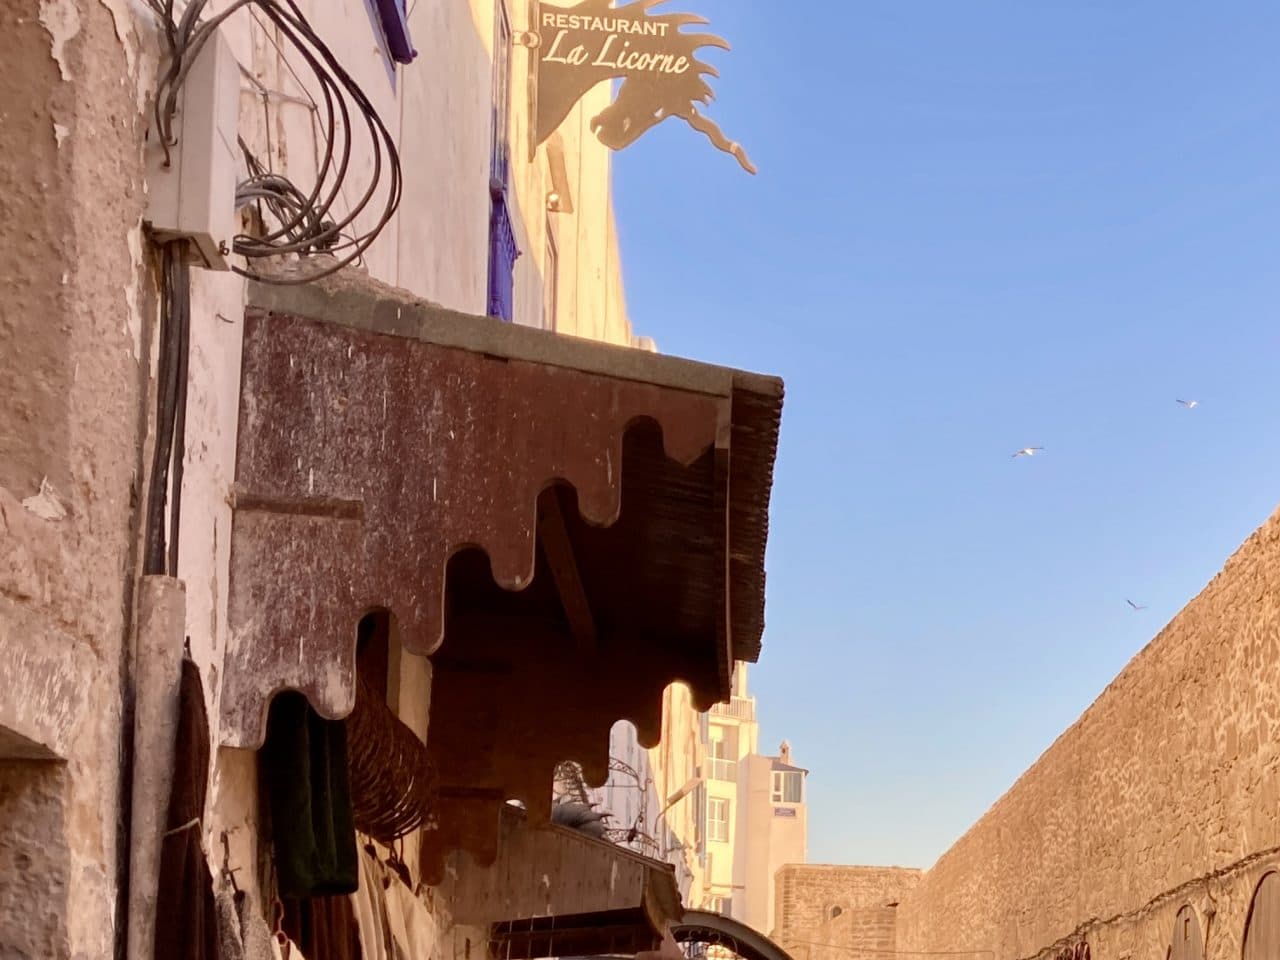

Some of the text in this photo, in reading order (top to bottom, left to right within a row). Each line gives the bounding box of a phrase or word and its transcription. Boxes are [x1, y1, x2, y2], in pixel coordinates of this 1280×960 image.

[543, 13, 669, 36] RESTAURANT
[542, 29, 689, 74] La Licorne
